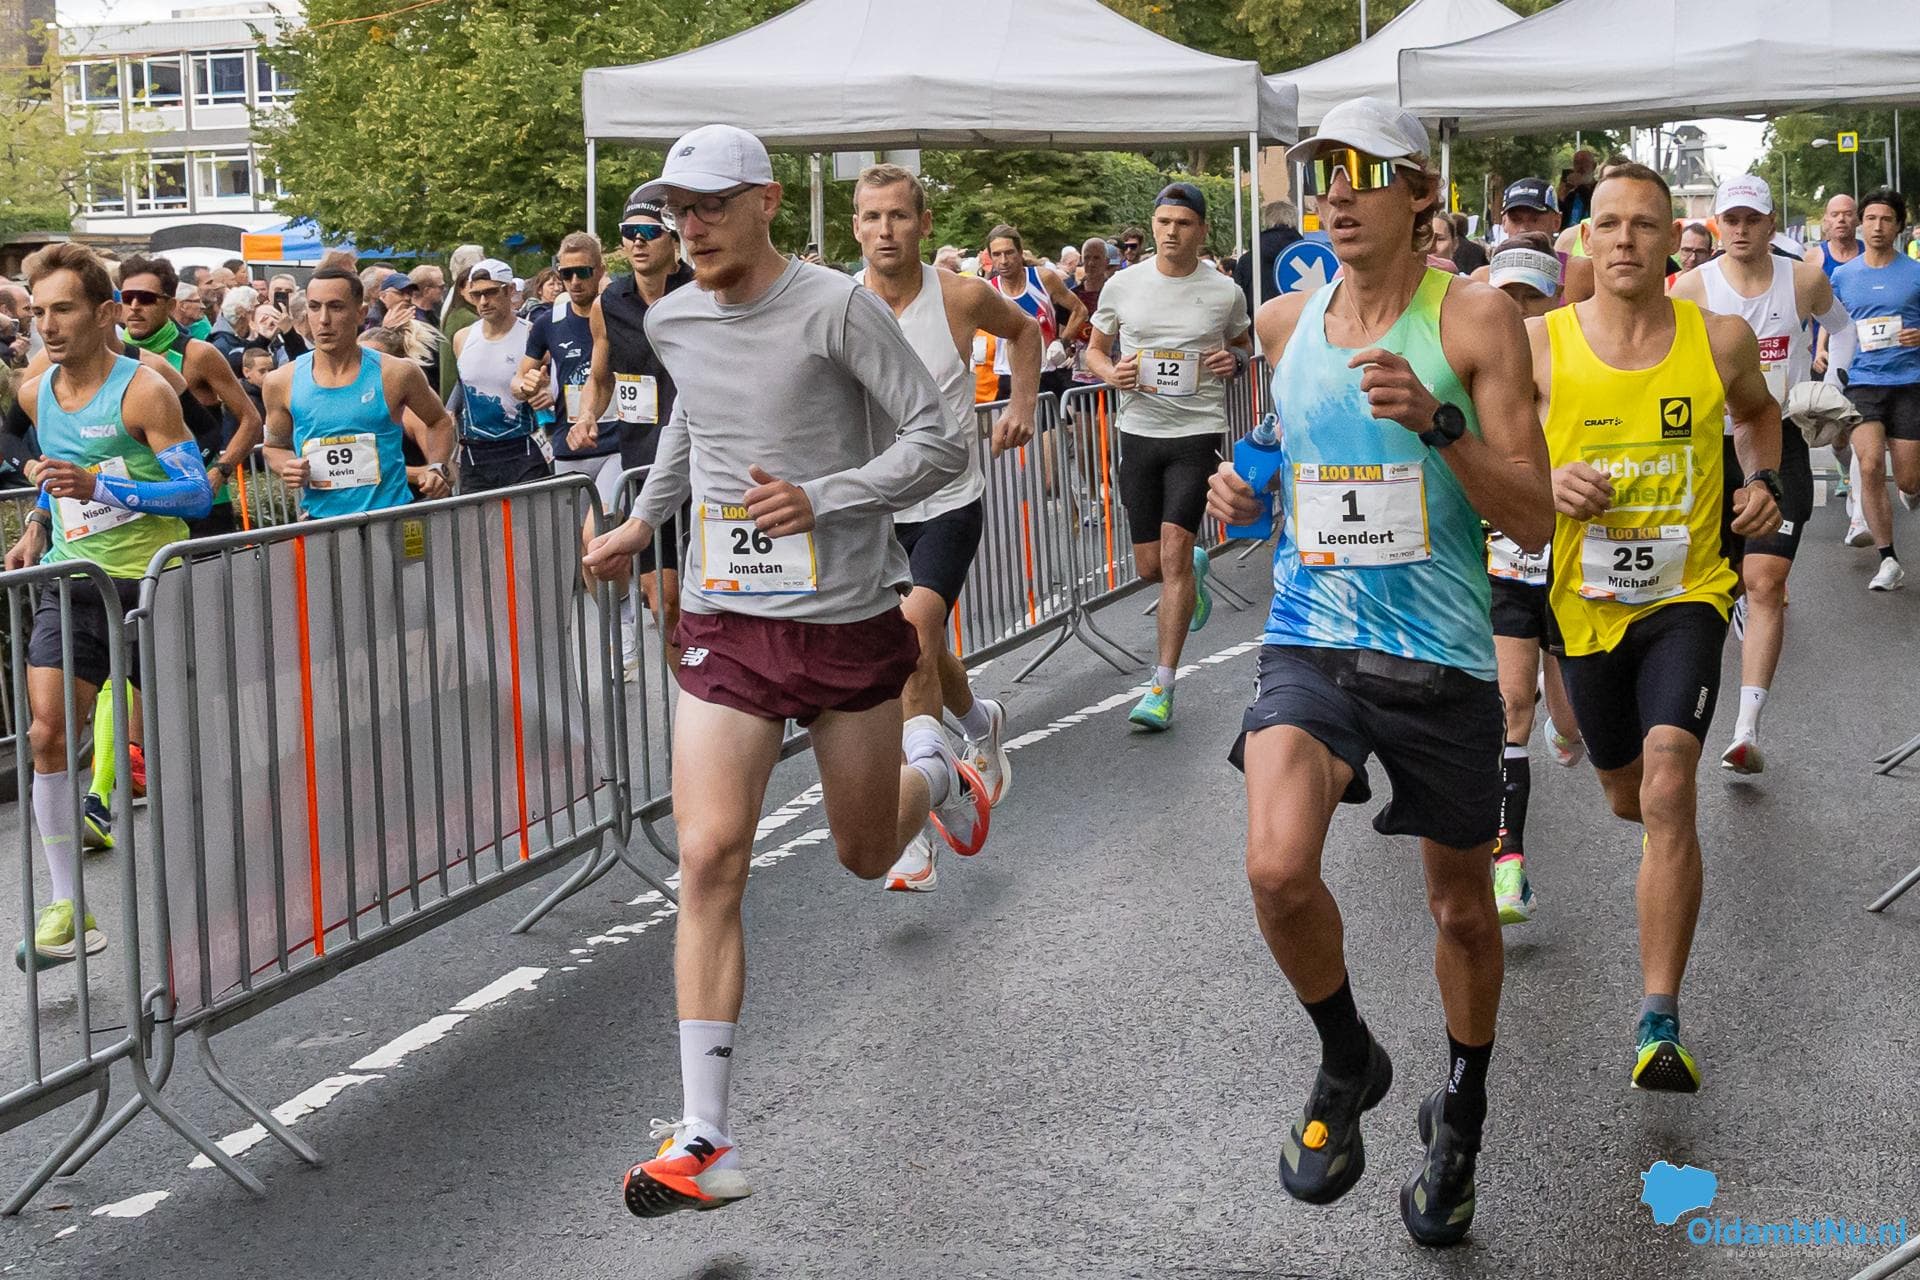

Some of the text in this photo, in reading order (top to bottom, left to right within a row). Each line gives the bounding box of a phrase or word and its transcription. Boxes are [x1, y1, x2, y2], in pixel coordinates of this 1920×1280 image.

[1871, 324, 1886, 336] 17
[1757, 339, 1780, 348] ERS
[1760, 348, 1787, 359] ONIA
[1157, 362, 1180, 376] 12
[620, 385, 637, 400] 89
[1584, 419, 1614, 427] CRAFT
[327, 448, 353, 465] 69
[1320, 465, 1350, 481] 100
[1355, 465, 1382, 480] KM
[82, 506, 112, 520] Nison
[722, 506, 747, 518] 100
[1341, 490, 1366, 522] 1
[1318, 530, 1395, 545] Leendert
[1608, 527, 1660, 539] 100 KM
[730, 528, 773, 554] 26
[1613, 547, 1654, 571] 25
[729, 562, 783, 574] Jonatan
[1694, 686, 1709, 719] FUSION
